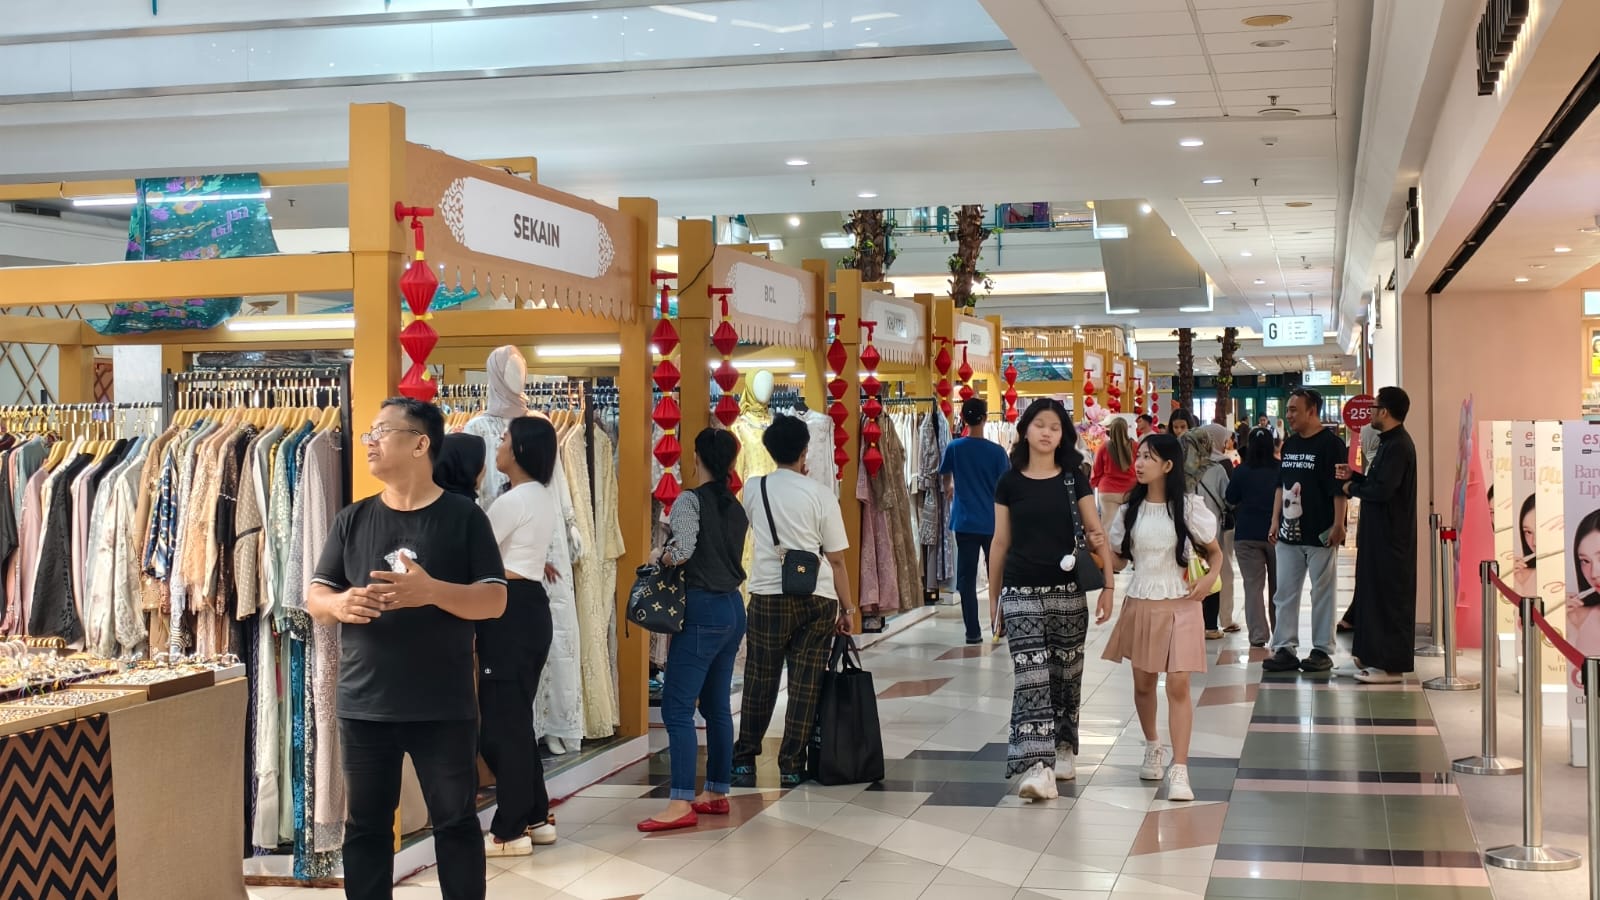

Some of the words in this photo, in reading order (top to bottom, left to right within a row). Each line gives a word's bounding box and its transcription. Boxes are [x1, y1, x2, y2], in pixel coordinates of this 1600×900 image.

[513, 213, 560, 249] SEKAIN
[764, 284, 777, 305] BCL
[1269, 323, 1278, 340] G
[1582, 434, 1600, 448] es
